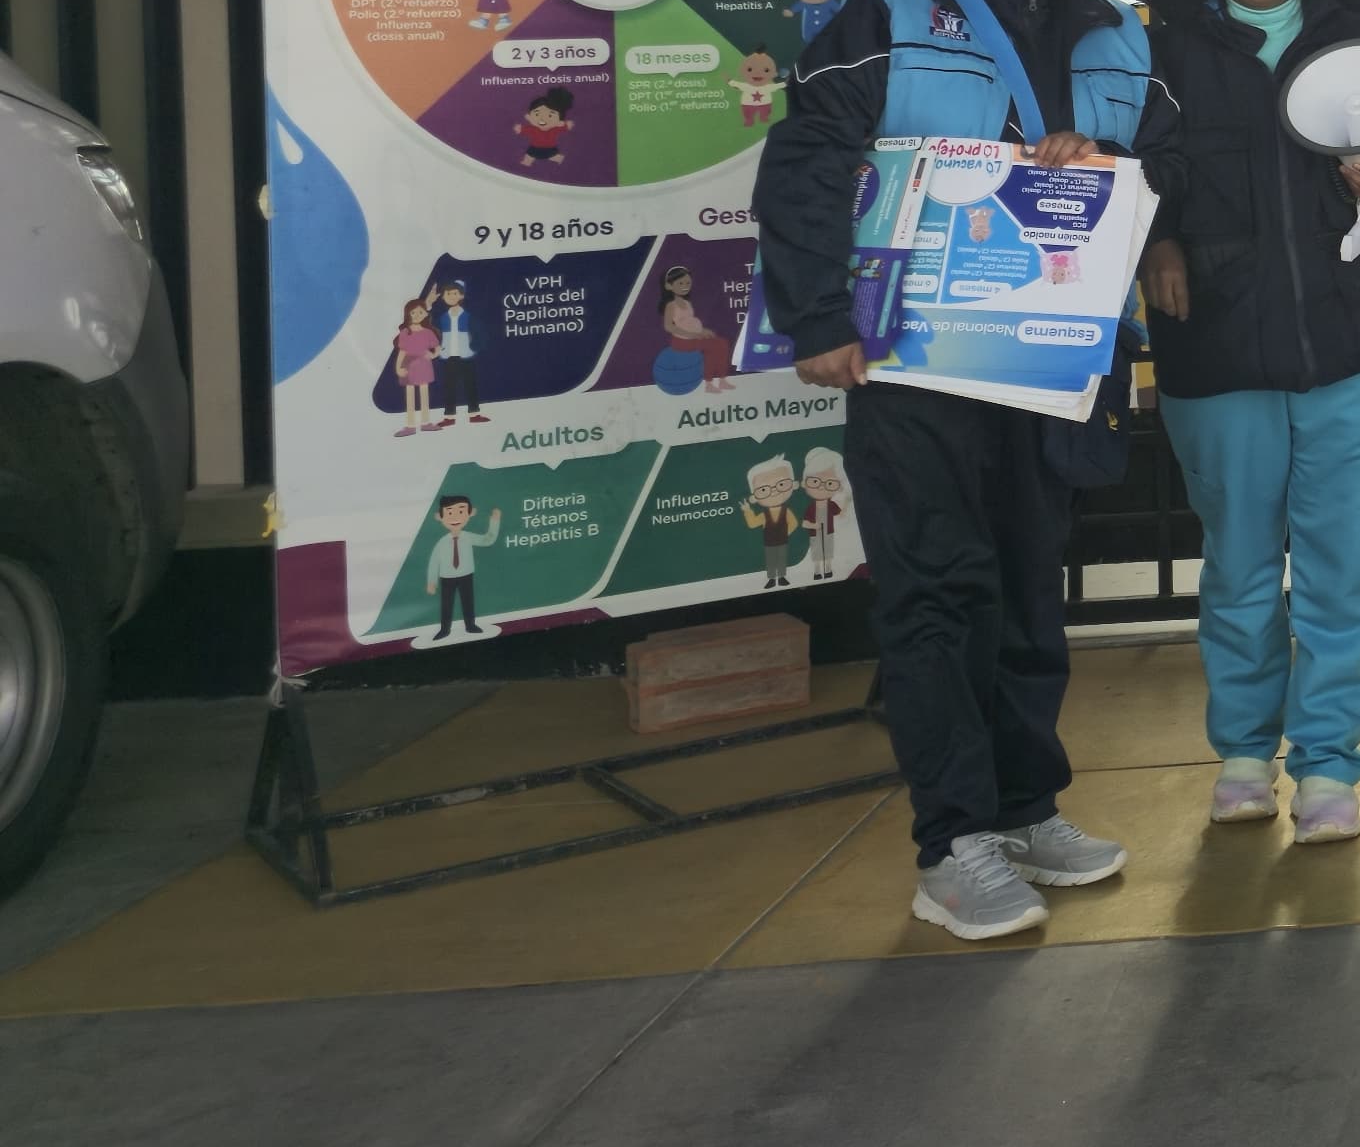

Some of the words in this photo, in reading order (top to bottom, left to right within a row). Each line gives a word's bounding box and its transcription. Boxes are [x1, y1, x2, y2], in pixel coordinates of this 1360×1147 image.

[715, 2, 763, 11] Hepatitis
[764, 2, 774, 10] A
[511, 48, 522, 60] 2
[526, 50, 535, 62] y
[540, 48, 549, 59] 3
[555, 46, 596, 59] años
[635, 52, 652, 64] 18
[656, 52, 711, 64] meses
[481, 76, 534, 86] Influenza
[537, 75, 571, 85] (dosis
[575, 73, 610, 83] anual)
[475, 226, 490, 244] 9
[497, 227, 512, 247] y
[519, 222, 545, 241] 18
[551, 218, 614, 238] años
[525, 276, 562, 289] VPH
[503, 289, 554, 309] (Virus
[559, 288, 585, 301] del
[505, 306, 584, 322] Papiloma
[506, 319, 584, 337] Humano)
[931, 320, 949, 334] de
[954, 319, 1015, 336] Nacional
[1025, 324, 1095, 342] Esquema
[677, 405, 759, 430] Adulto
[765, 394, 839, 420] Mayor
[501, 425, 604, 453] Adultos
[523, 492, 586, 512] Difteria
[656, 490, 729, 511] Influenza
[522, 509, 588, 529] Tétanos
[652, 505, 734, 526] Neumococo
[506, 522, 583, 549] Hepatitis
[587, 523, 600, 537] B
